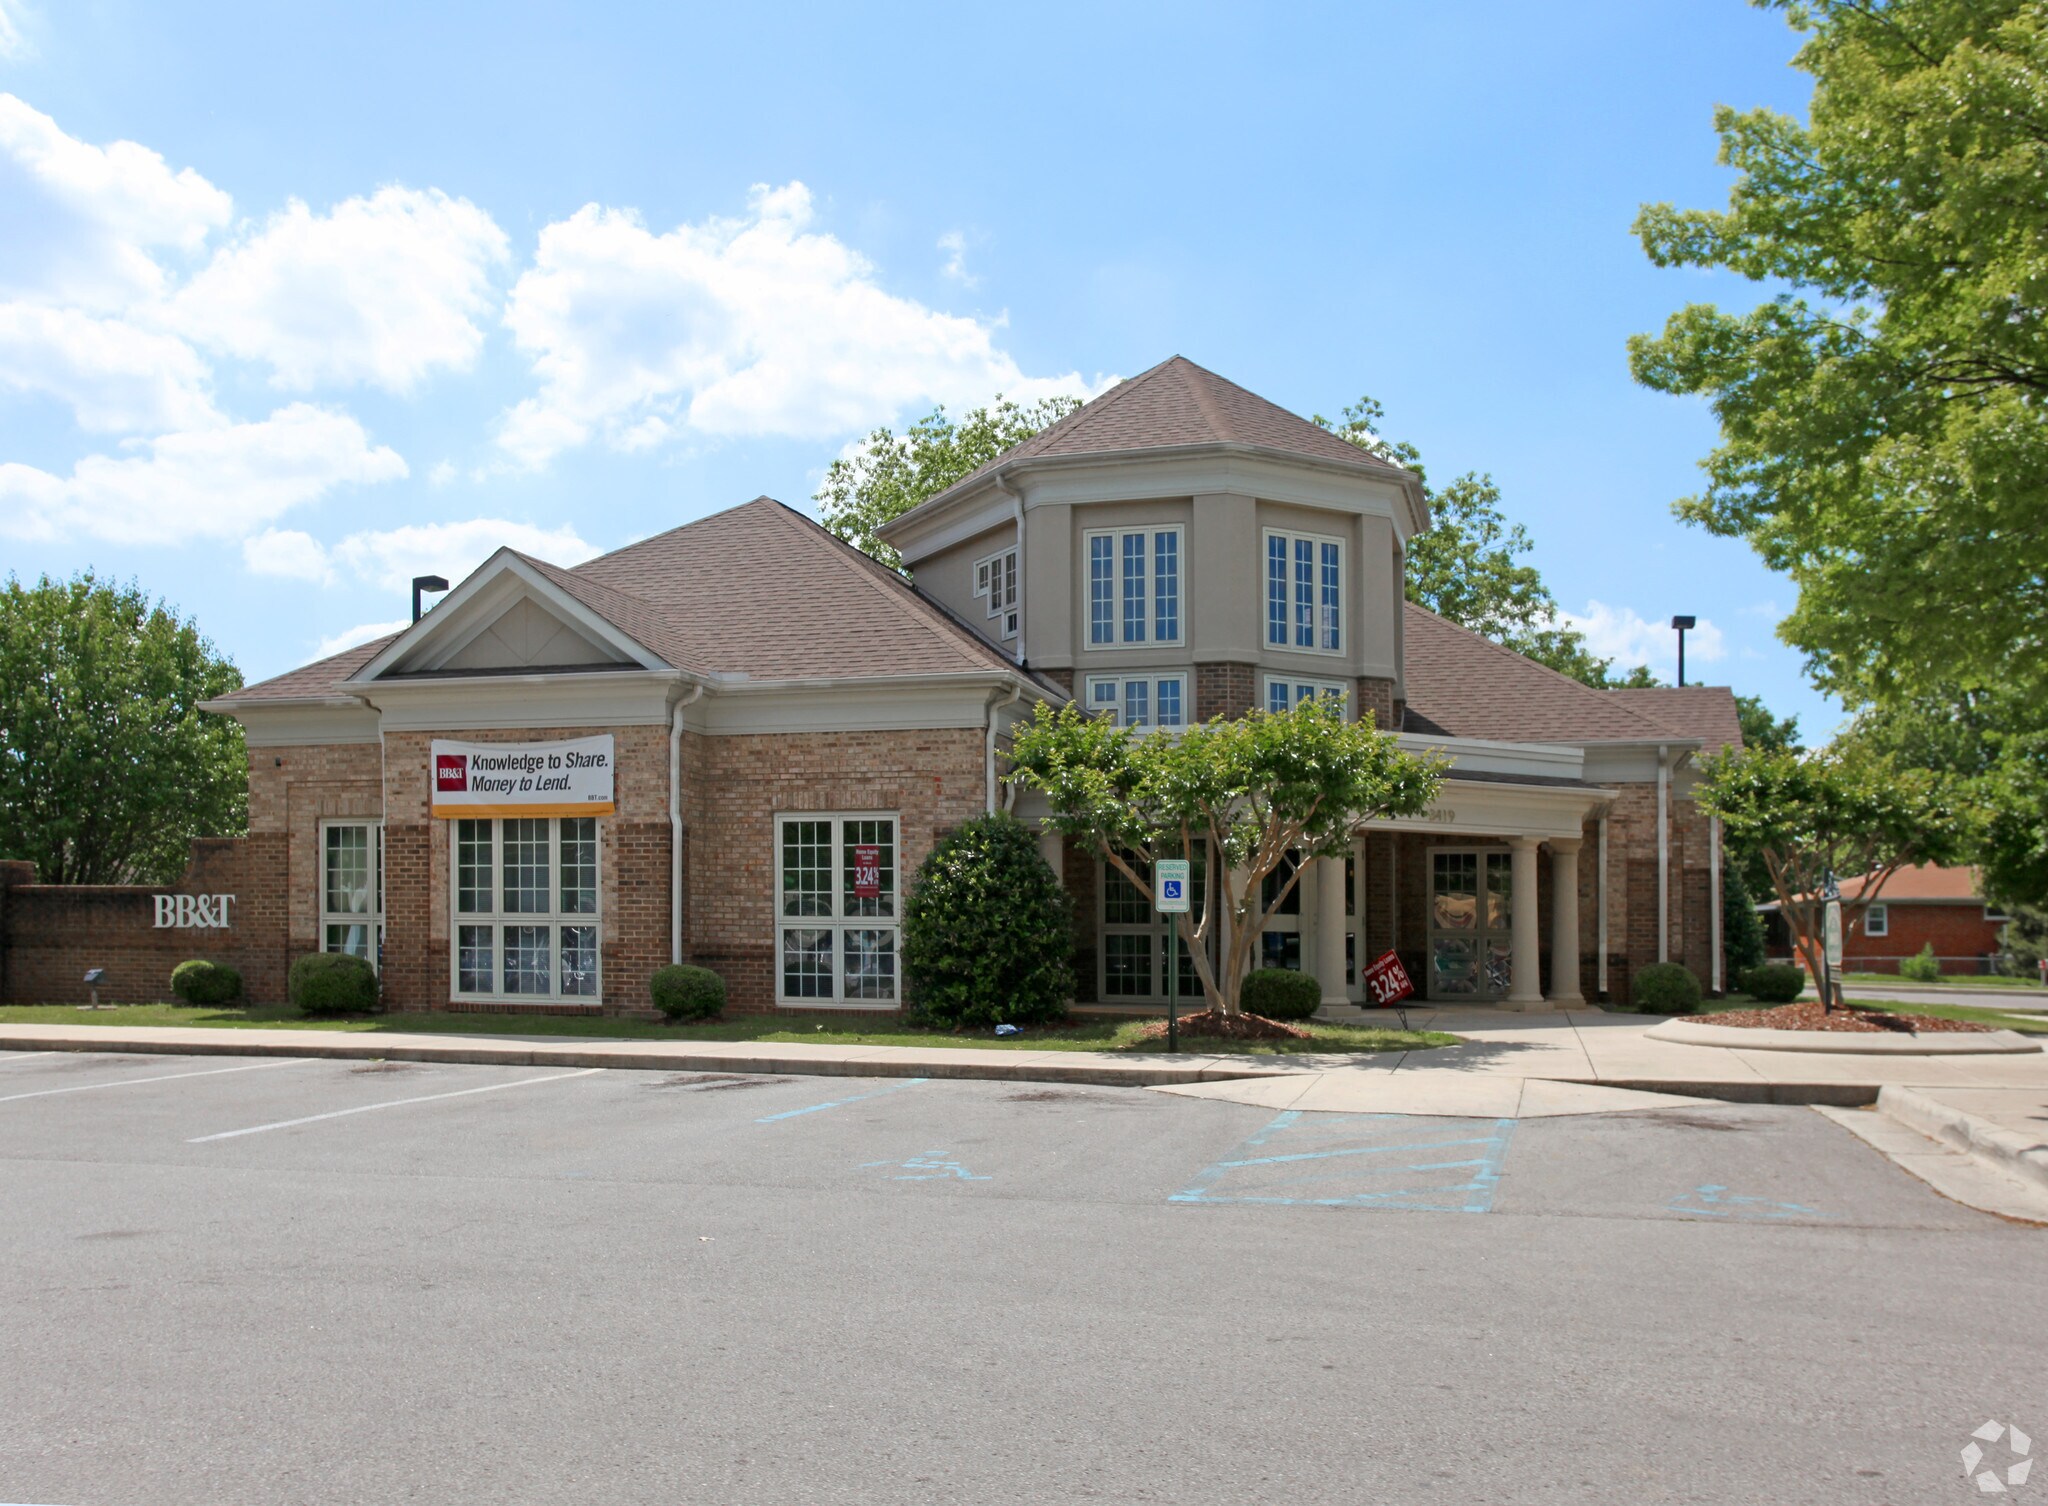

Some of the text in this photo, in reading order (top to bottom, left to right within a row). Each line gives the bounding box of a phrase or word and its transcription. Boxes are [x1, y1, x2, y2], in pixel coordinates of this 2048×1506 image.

[471, 751, 609, 773] Knowledge to Share.
[439, 767, 464, 779] BB&T
[471, 774, 572, 795] Money to Lend.
[152, 893, 236, 928] BB&T
